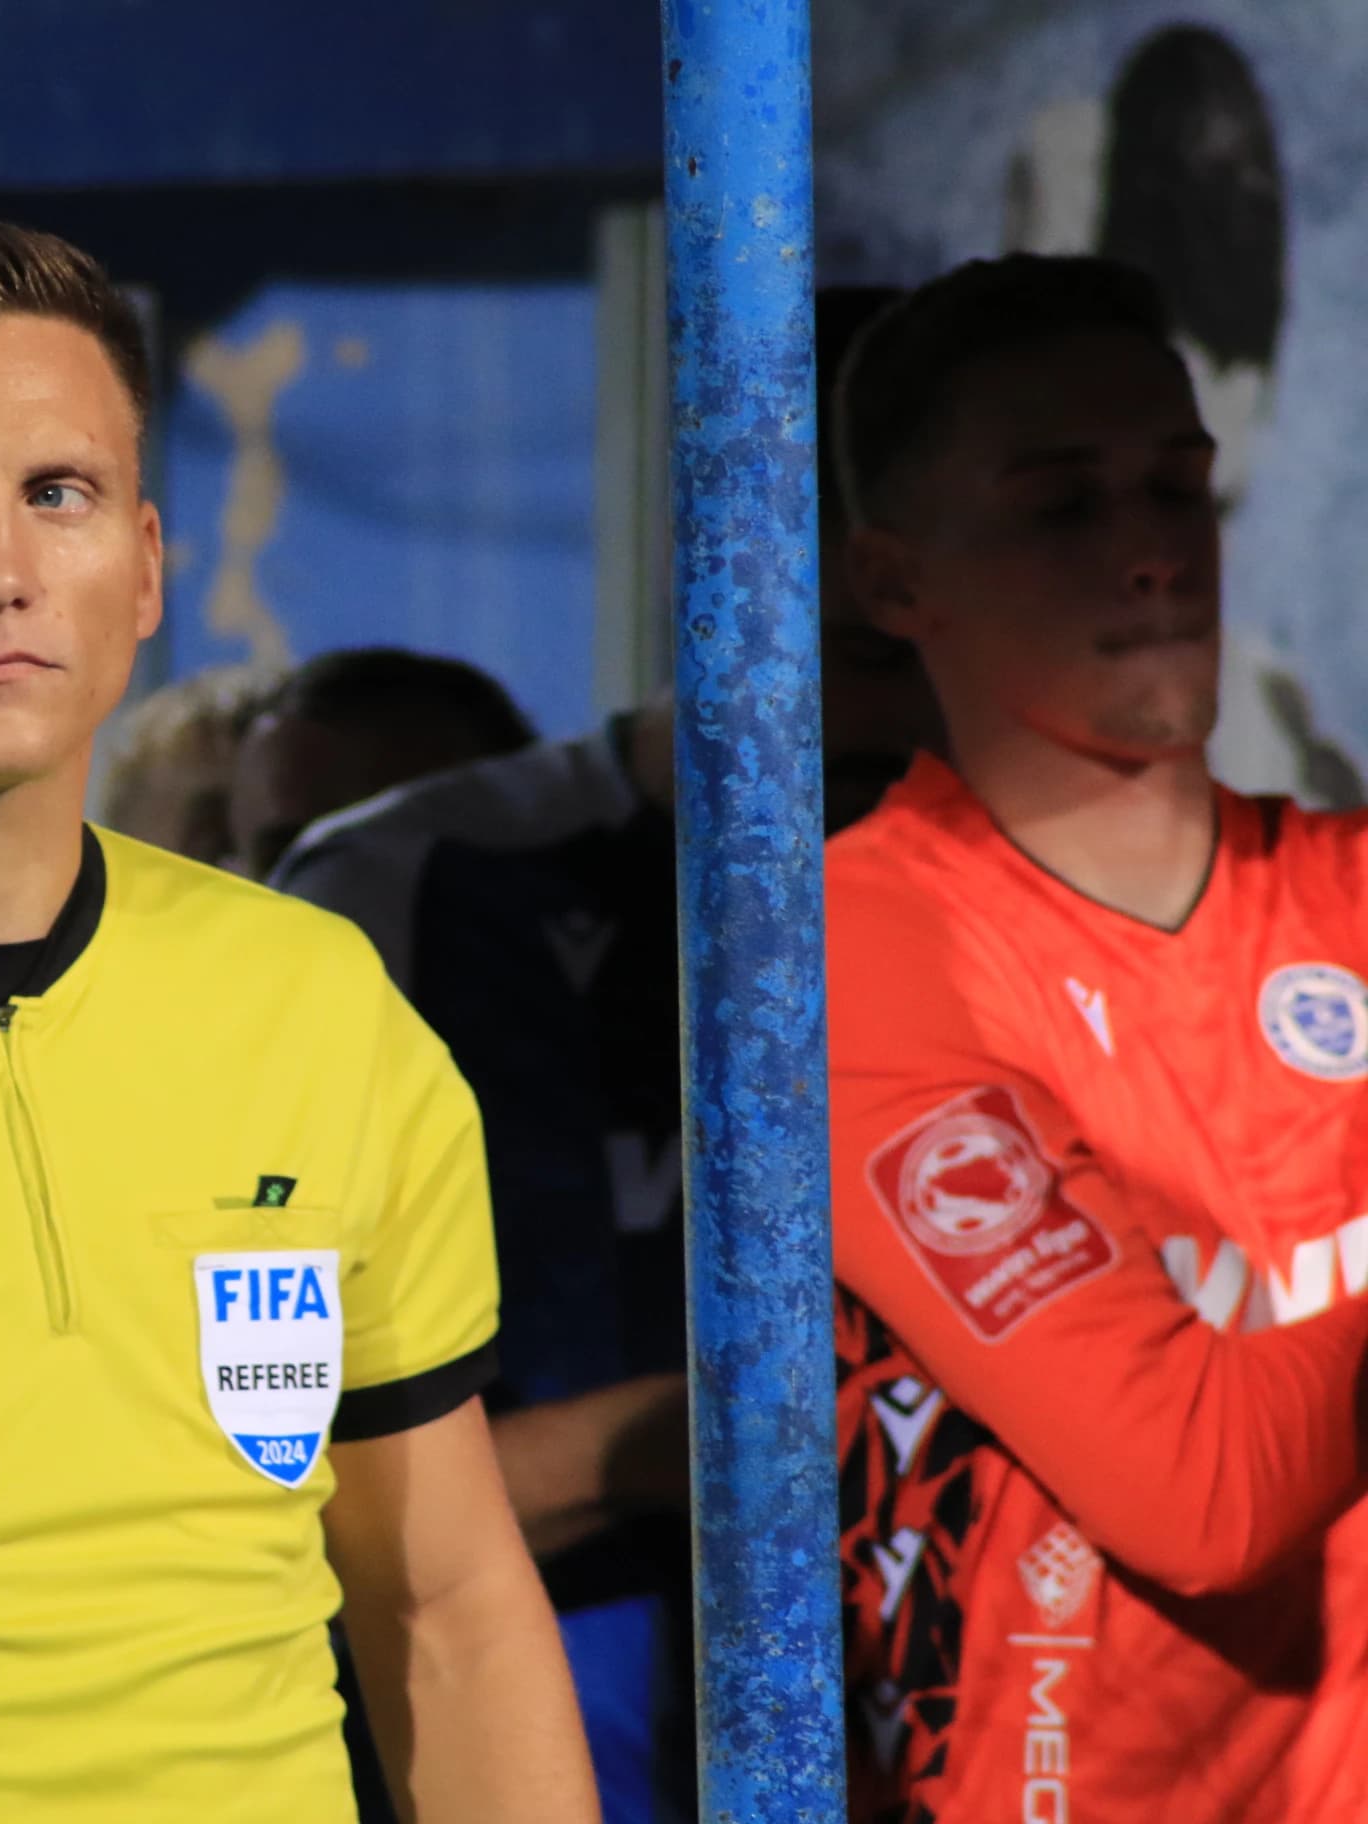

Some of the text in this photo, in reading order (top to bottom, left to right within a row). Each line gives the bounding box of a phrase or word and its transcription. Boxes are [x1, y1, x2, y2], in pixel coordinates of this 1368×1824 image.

[212, 1265, 330, 1322] FIFA
[217, 1363, 329, 1391] REFEREE
[255, 1440, 308, 1465] 2024
